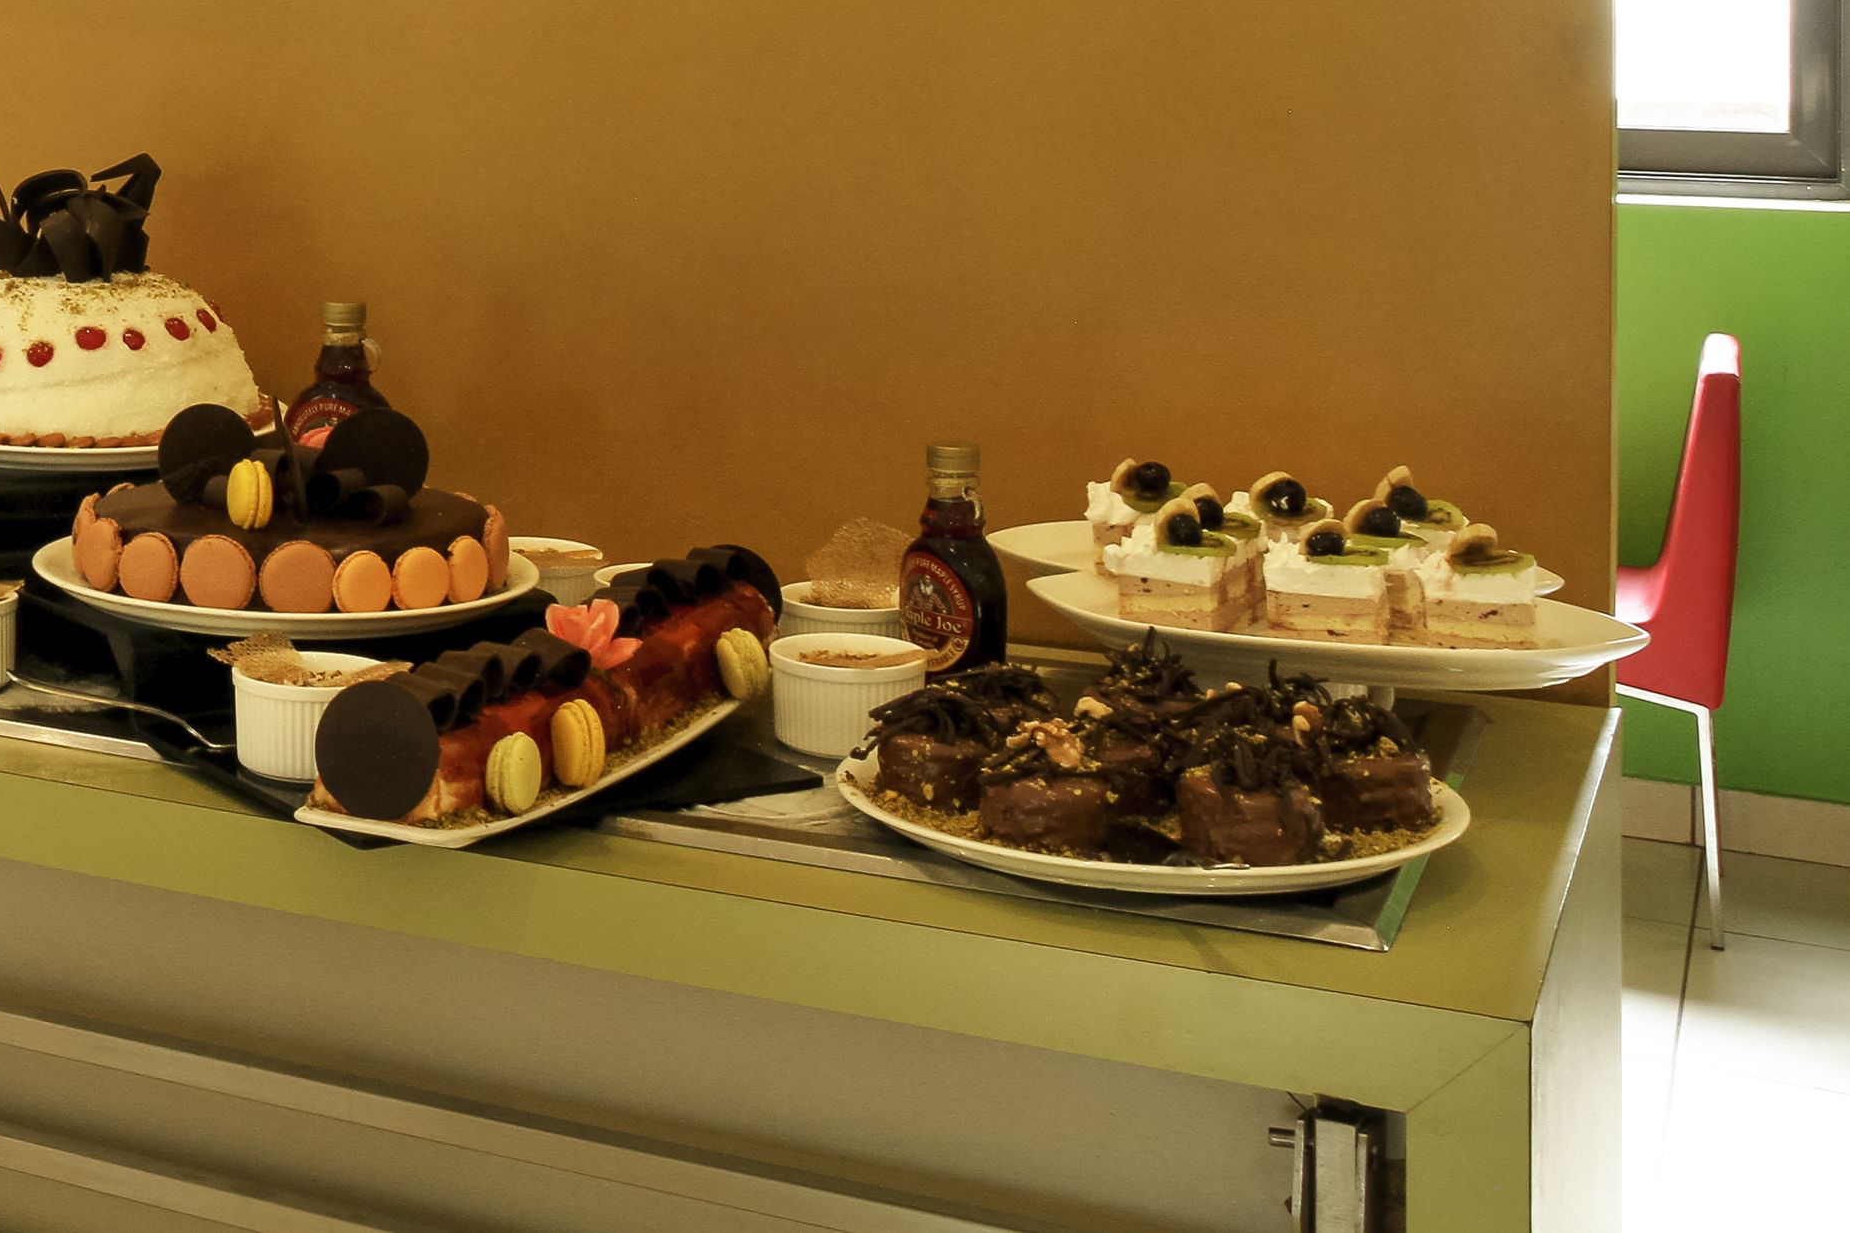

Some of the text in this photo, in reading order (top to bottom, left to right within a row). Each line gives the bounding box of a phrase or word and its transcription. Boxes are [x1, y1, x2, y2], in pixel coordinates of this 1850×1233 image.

[318, 403, 339, 413] PURE
[930, 563, 954, 587] MAPLE
[948, 584, 968, 612] SYRUP
[936, 616, 963, 634] Joe
